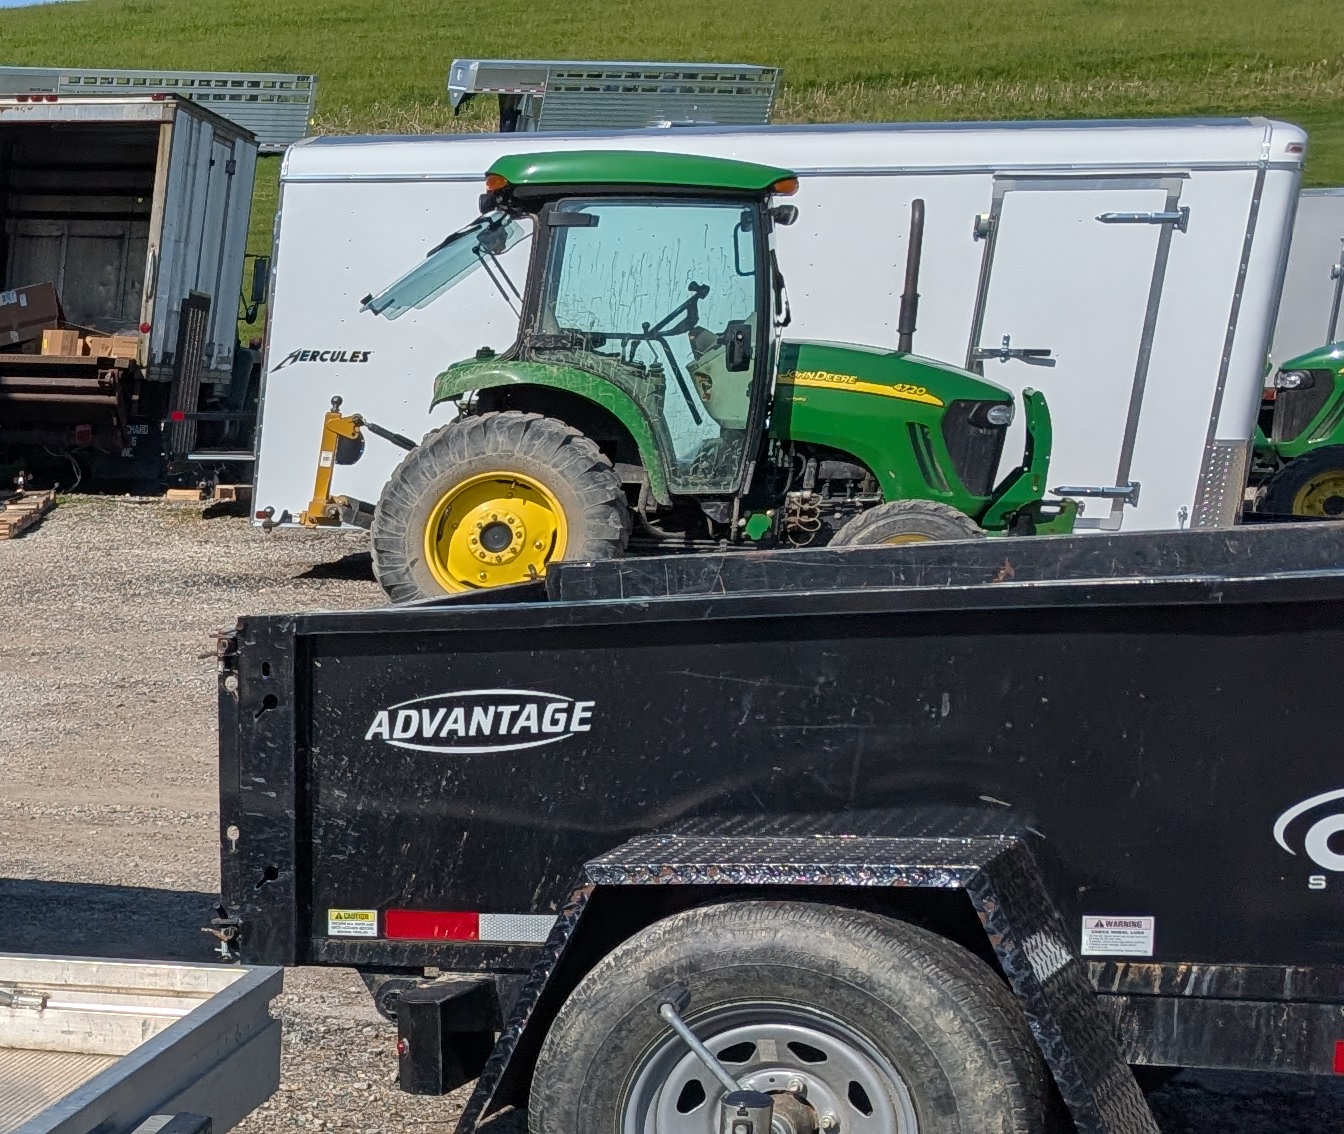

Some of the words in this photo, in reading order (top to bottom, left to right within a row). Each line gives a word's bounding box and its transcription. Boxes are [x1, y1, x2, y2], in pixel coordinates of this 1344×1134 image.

[269, 348, 371, 373] HERCULES
[781, 369, 815, 380] JOHN
[815, 371, 858, 384] DEERE
[893, 383, 927, 396] 4720
[365, 701, 596, 741] ADVANTAGE
[1106, 920, 1142, 928] WARNING
